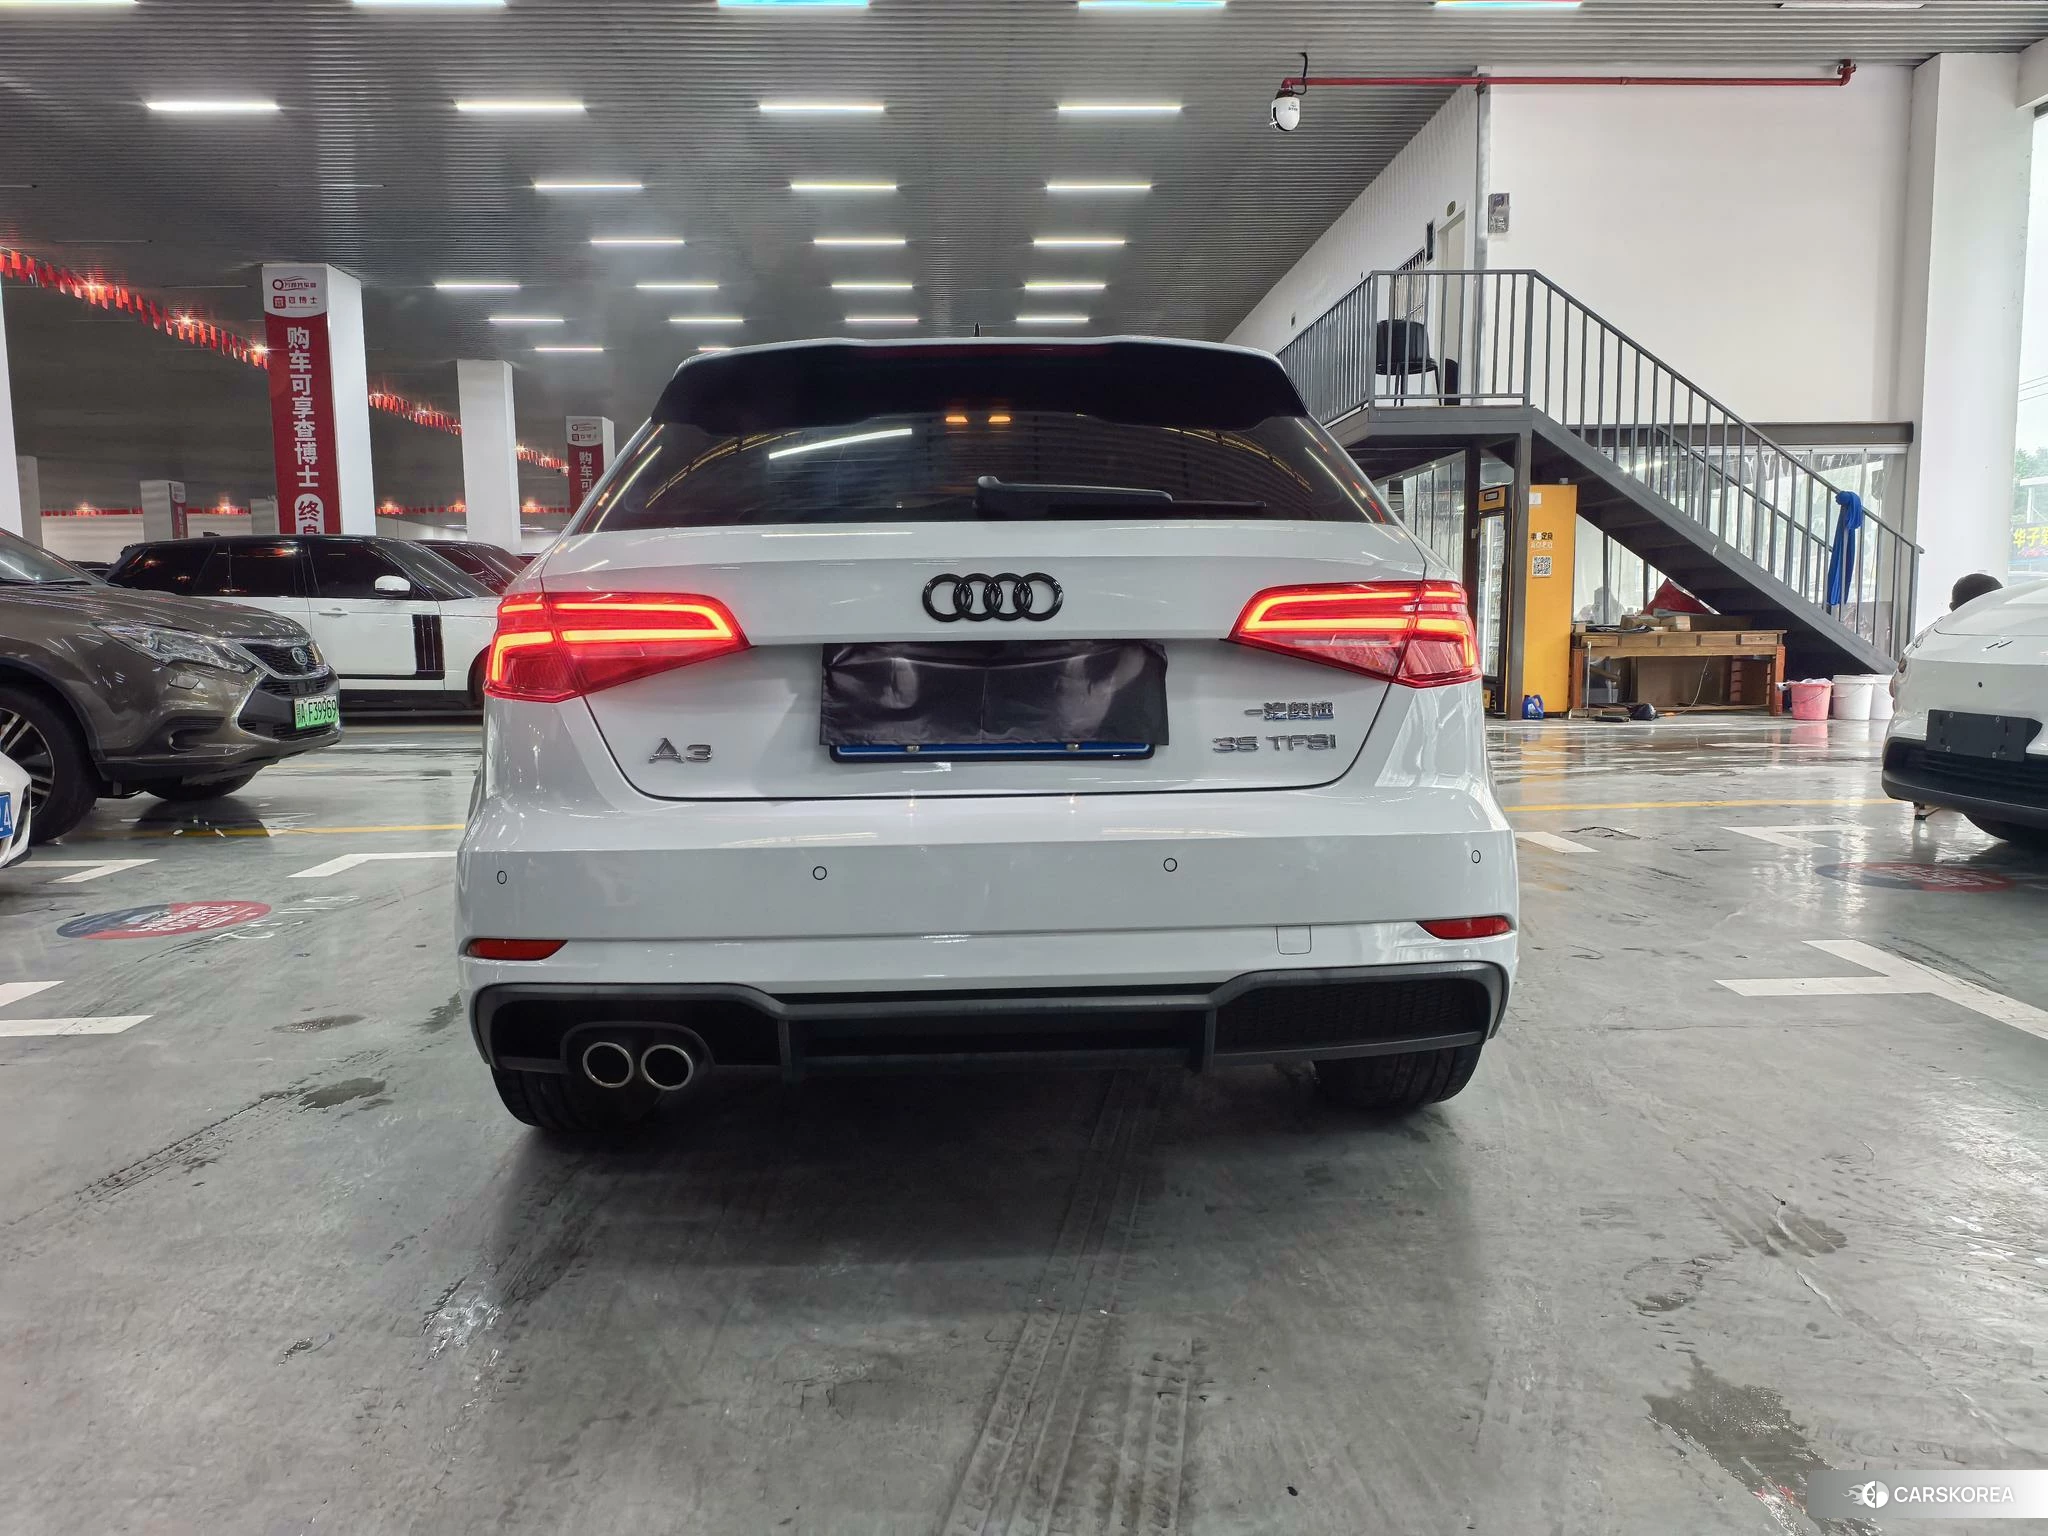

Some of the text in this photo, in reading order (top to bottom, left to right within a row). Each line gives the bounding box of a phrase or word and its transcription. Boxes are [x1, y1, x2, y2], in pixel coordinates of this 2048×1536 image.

[287, 327, 319, 488] 购车可享查博士
[648, 738, 712, 763] A3
[1212, 734, 1336, 753] 35 TFSI
